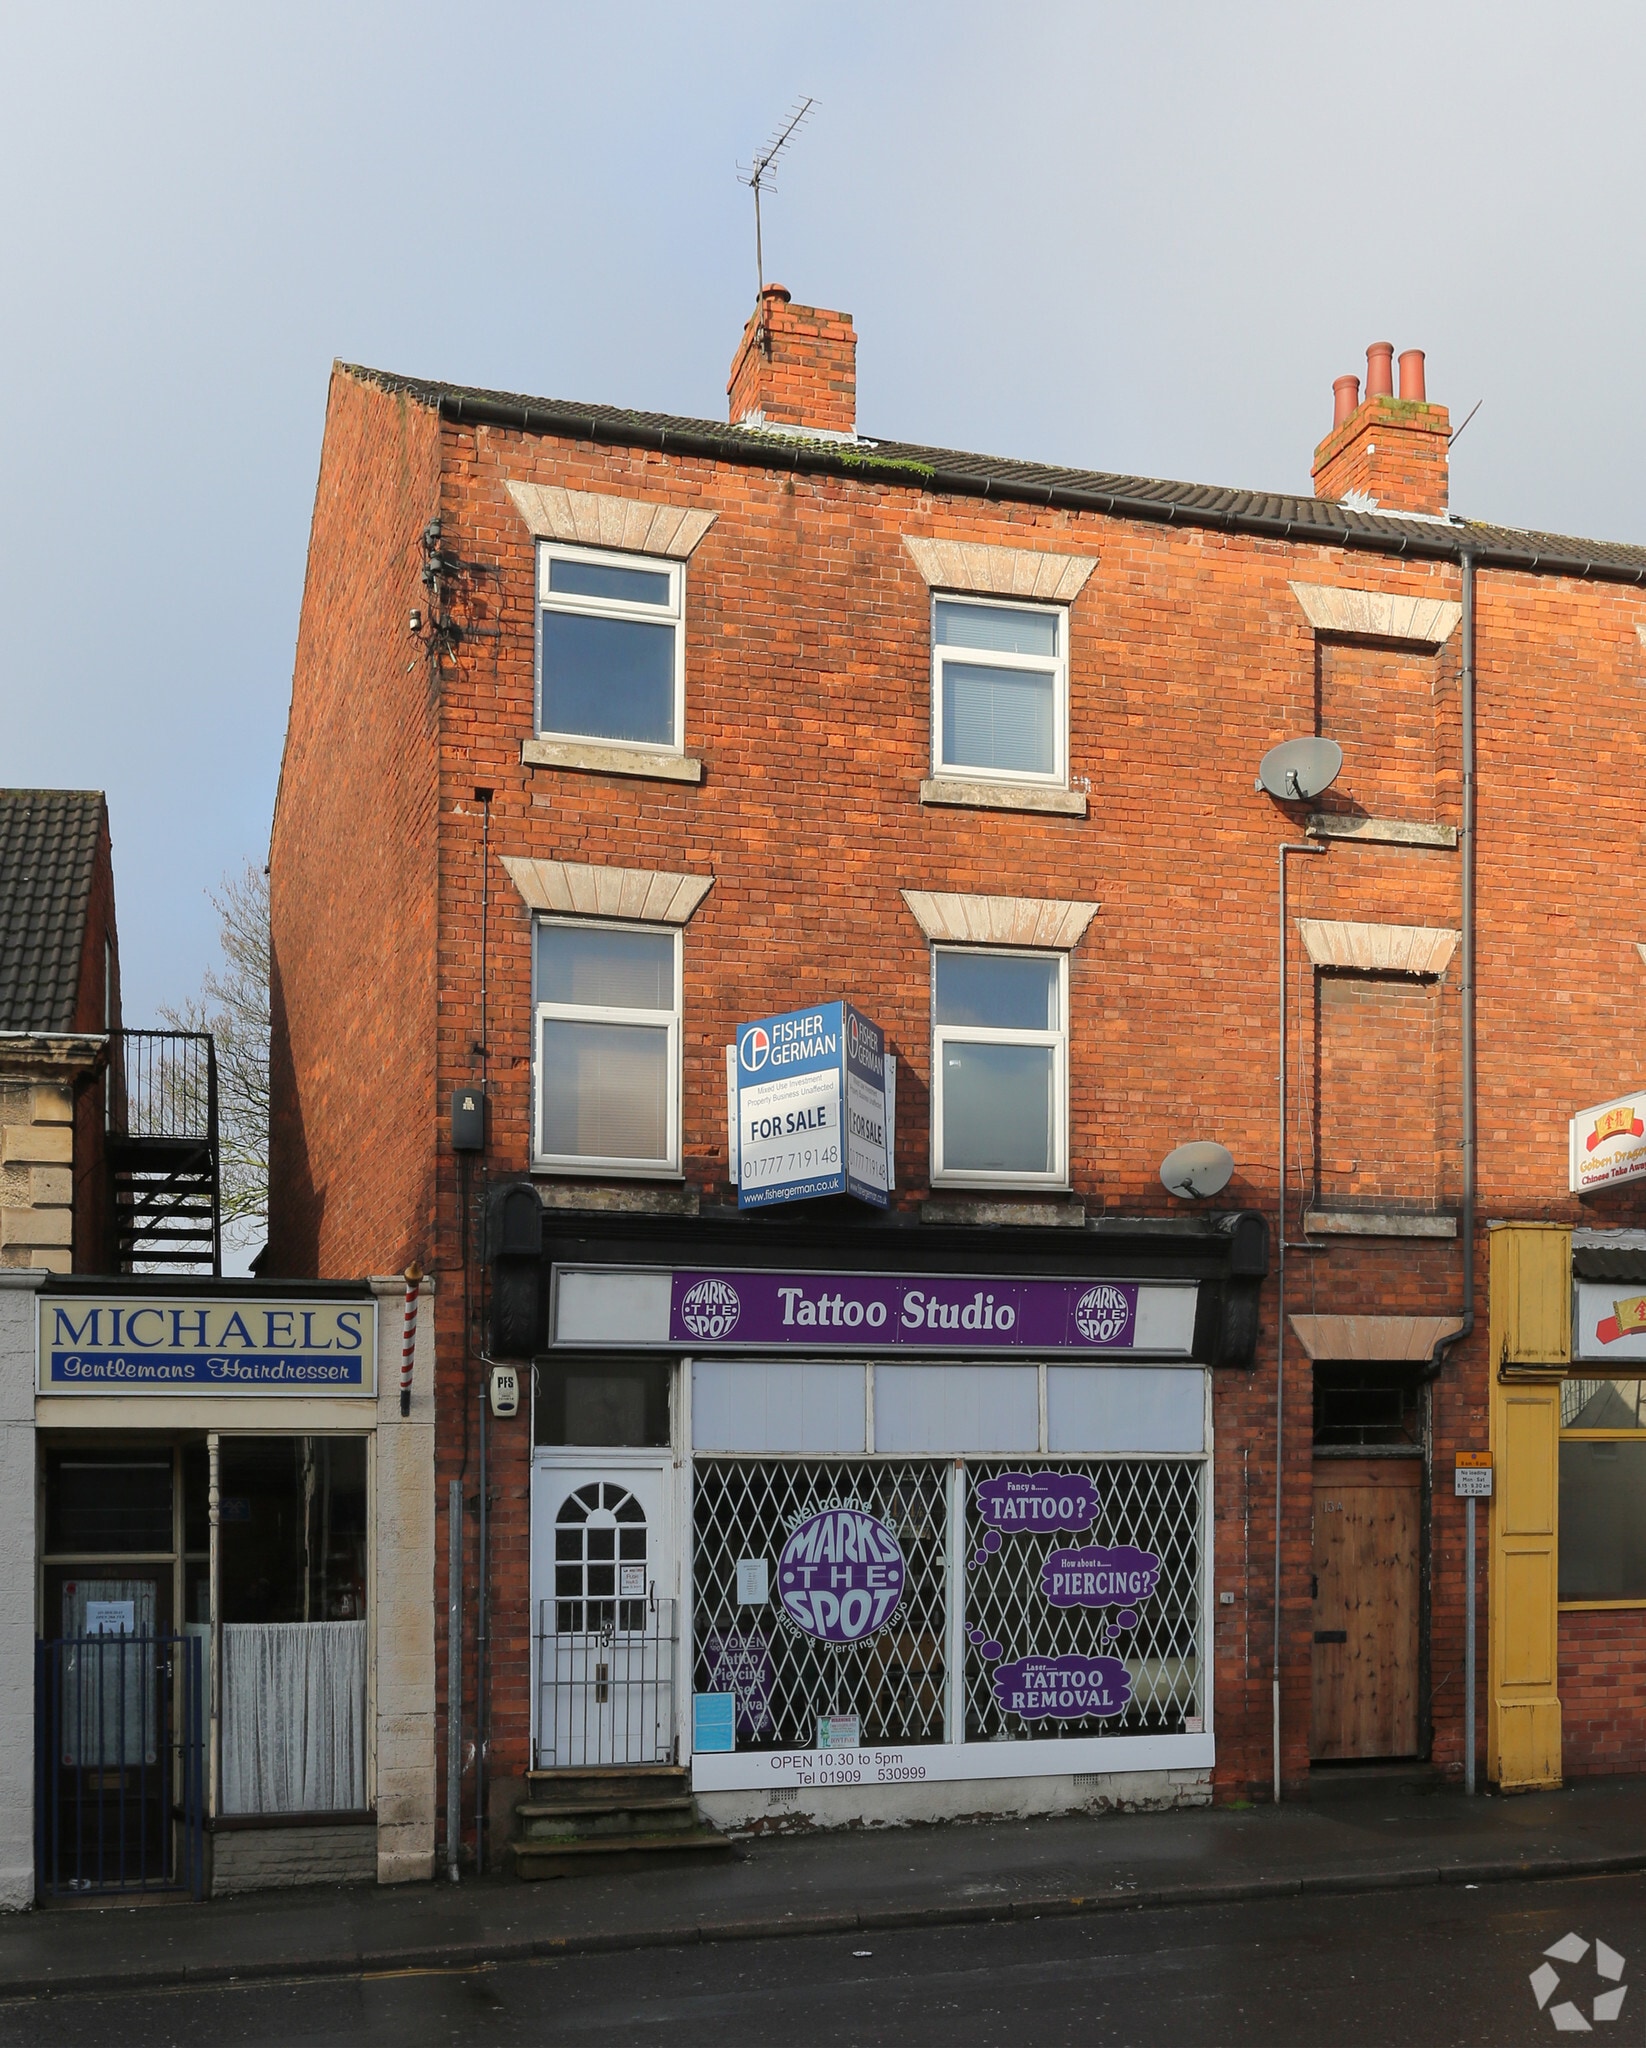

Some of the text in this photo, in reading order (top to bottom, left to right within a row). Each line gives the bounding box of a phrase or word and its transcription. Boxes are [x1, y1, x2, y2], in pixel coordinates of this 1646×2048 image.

[772, 1014, 824, 1045] FISHER
[859, 1022, 878, 1052] FISHER
[770, 1033, 836, 1066] GERMAN
[858, 1044, 883, 1077] GERMAN
[747, 1096, 771, 1107] Property
[772, 1089, 800, 1102] Business
[800, 1083, 834, 1096] Unaffected
[757, 1074, 823, 1095] Mixed Use Investment
[751, 1106, 827, 1141] FOR SALE
[852, 1112, 882, 1145] FOR SALE
[743, 1145, 838, 1179] 01777 719148
[1581, 1172, 1609, 1185] Chinese
[1611, 1166, 1628, 1177] Take
[743, 1178, 839, 1203] www.fishergerman.co.uk
[685, 1281, 738, 1304] MARKS
[1079, 1287, 1126, 1309] MARKS
[691, 1304, 732, 1316] THE
[777, 1287, 1016, 1330] Tattoo Studio
[1084, 1309, 1121, 1319] THE
[50, 1307, 362, 1350] MICHAELS
[684, 1315, 737, 1337] SPOT
[1078, 1319, 1125, 1340] SPOT
[63, 1356, 350, 1380] Gentlemans Hairdresser
[497, 1376, 514, 1389] PFS
[1007, 1481, 1030, 1492] Fancy
[782, 1496, 897, 1532] Welcome to
[990, 1496, 1087, 1519] TATTOO?
[784, 1512, 900, 1564] MARKS
[1061, 1558, 1076, 1568] How
[1077, 1558, 1096, 1568] about
[796, 1565, 887, 1588] THE
[1052, 1571, 1151, 1595] PIERCING?
[783, 1589, 899, 1638] SPOT
[775, 1600, 908, 1653] Tattoo & Piercing Studio
[728, 1637, 765, 1649] OPEN
[719, 1651, 758, 1666] Tattoo
[1022, 1670, 1104, 1689] TATTOO
[1011, 1689, 1114, 1709] REMOVAL
[770, 1752, 903, 1769] OPEN 10.30 to 5pm
[796, 1766, 926, 1785] Tel 01909 530999
